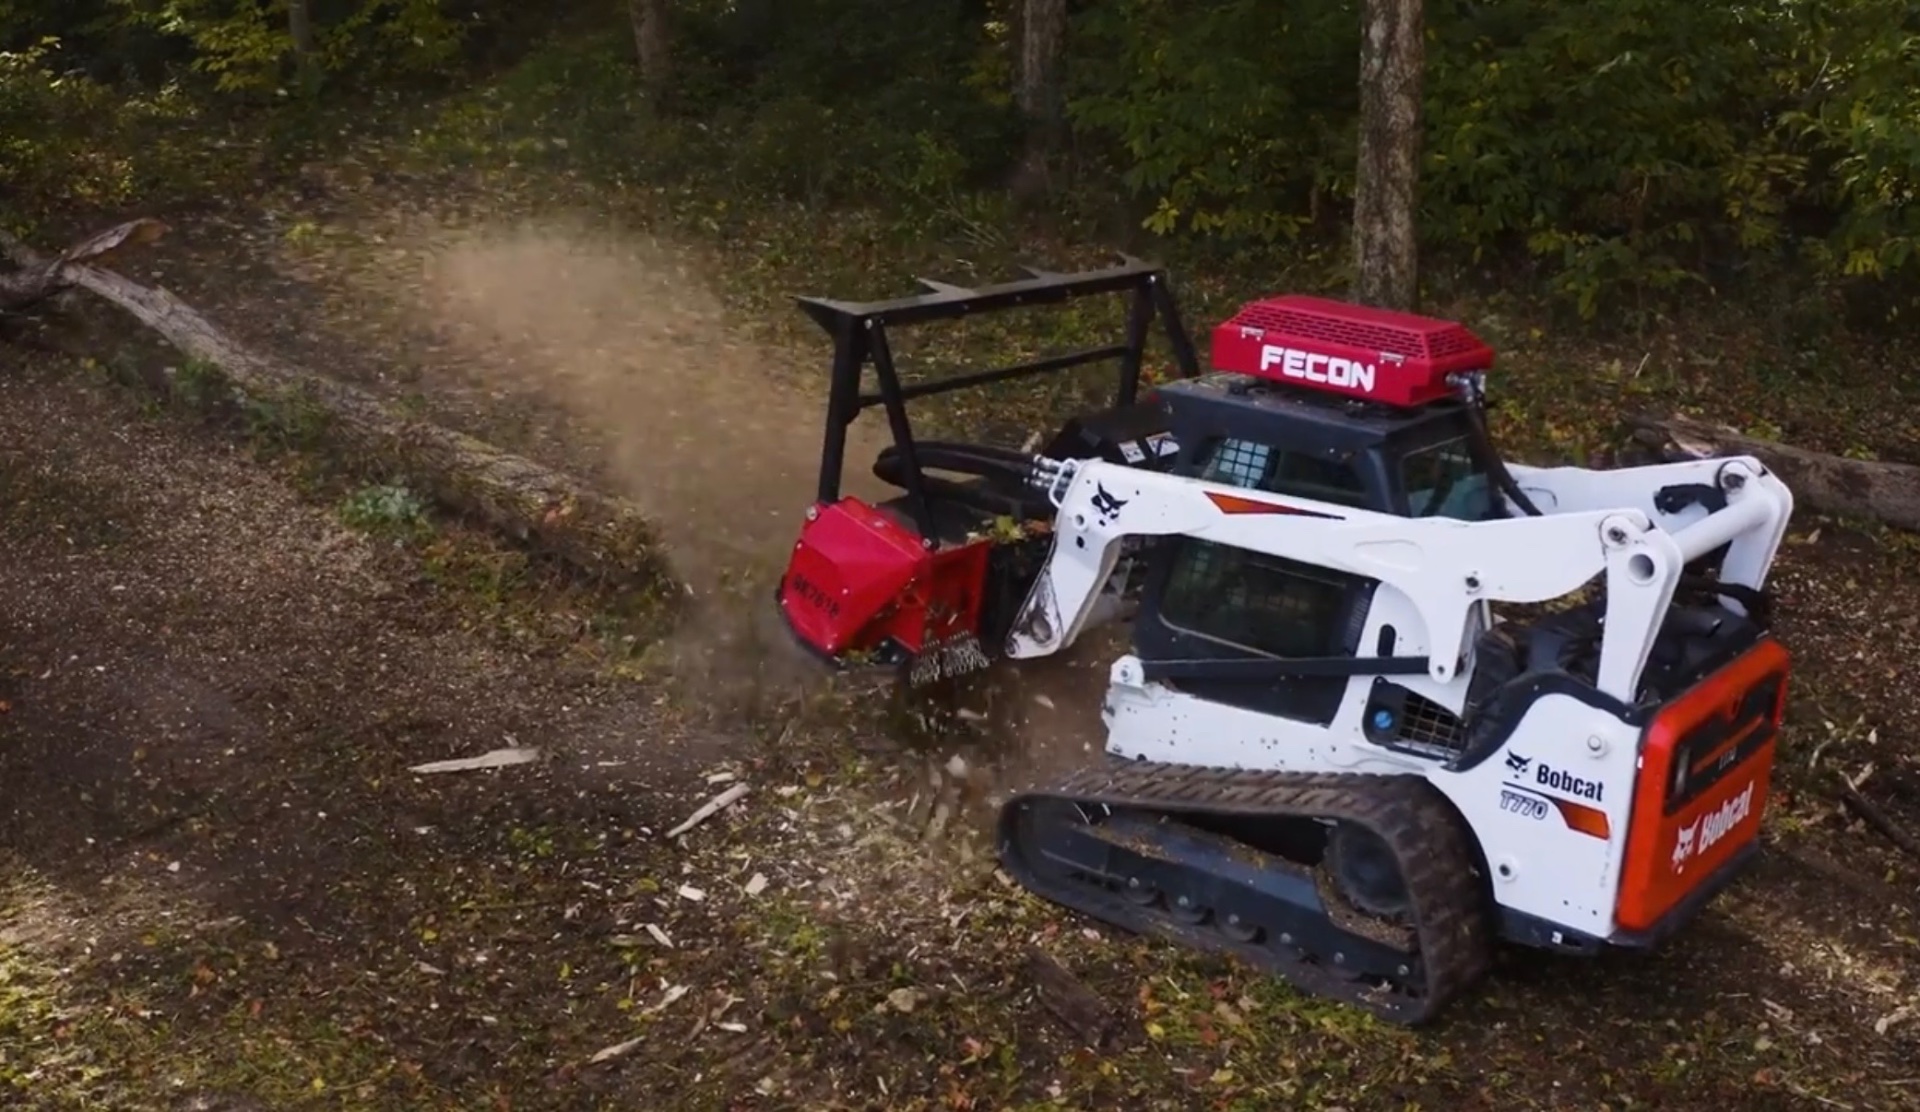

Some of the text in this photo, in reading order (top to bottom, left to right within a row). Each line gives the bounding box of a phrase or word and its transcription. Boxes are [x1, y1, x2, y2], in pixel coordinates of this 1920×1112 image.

[1260, 344, 1376, 393] FECON
[1500, 789, 1549, 821] T770
[1536, 763, 1604, 803] Bobcat
[1698, 780, 1754, 855] Bobcat
